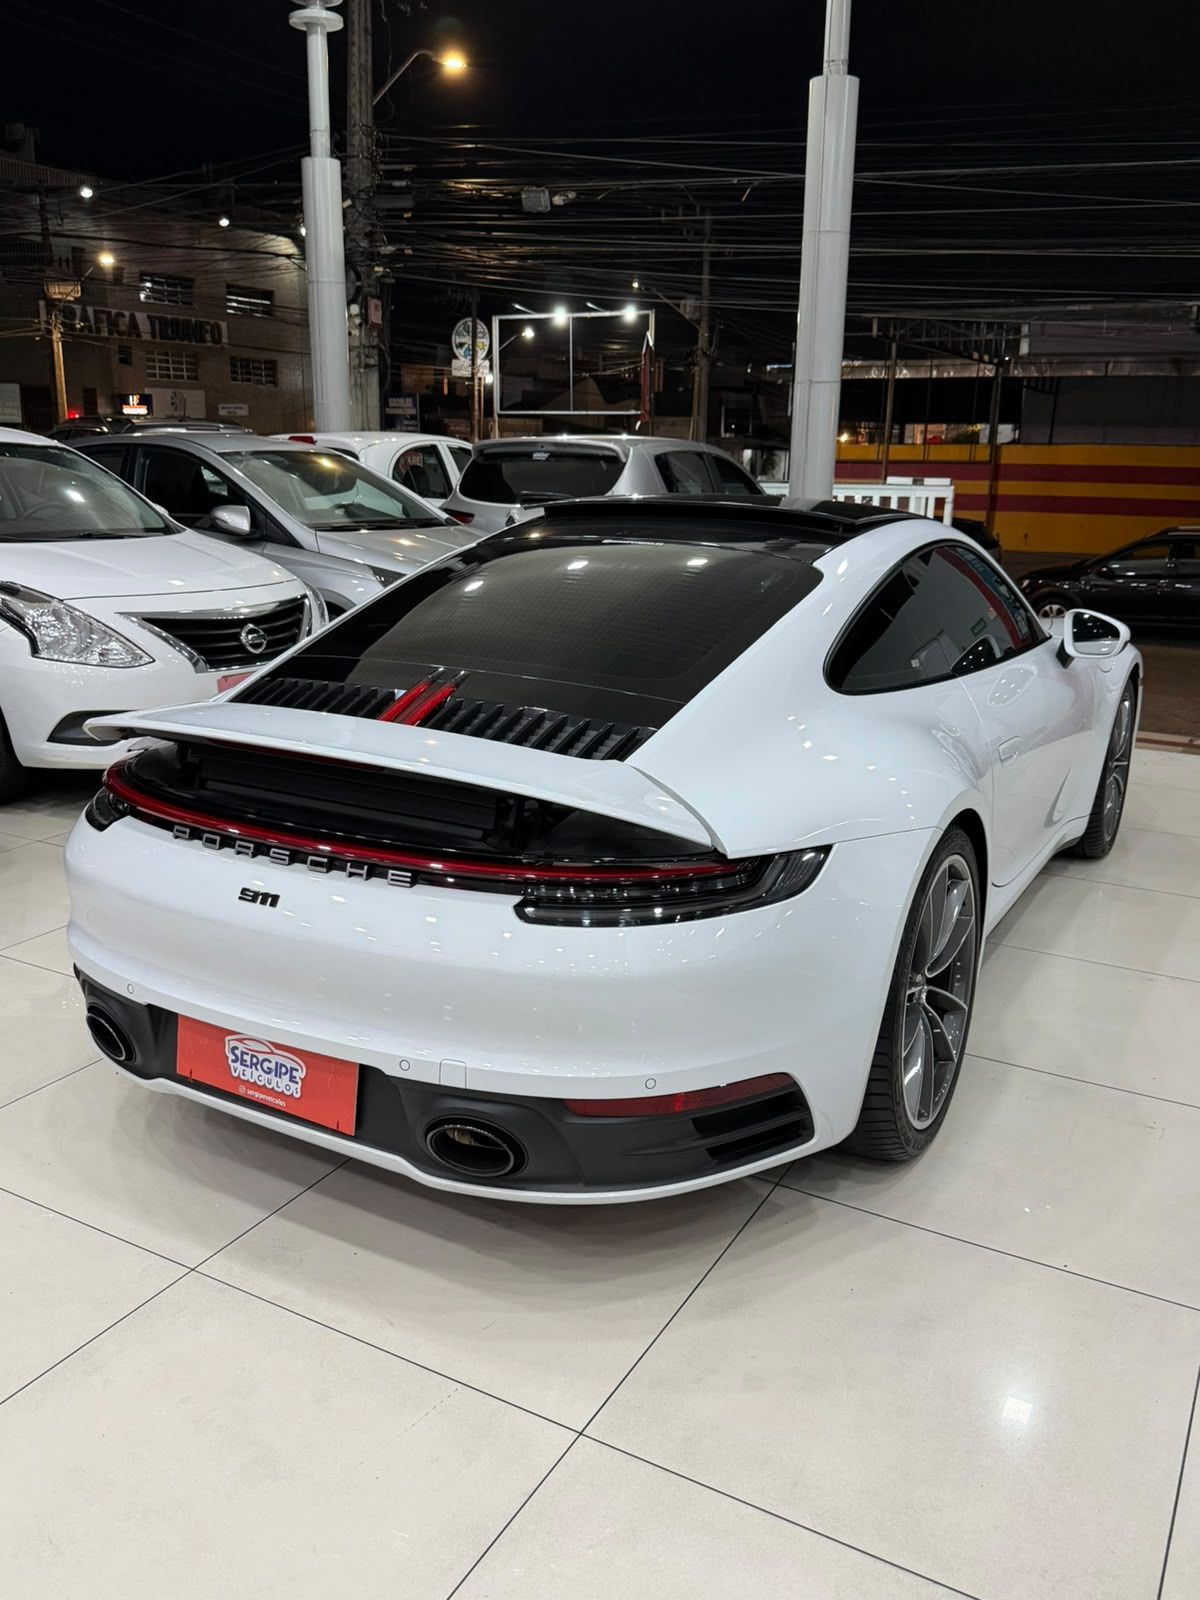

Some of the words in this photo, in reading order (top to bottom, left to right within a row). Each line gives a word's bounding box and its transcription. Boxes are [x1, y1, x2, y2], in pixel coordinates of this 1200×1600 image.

[46, 303, 143, 339] RAFICA
[173, 825, 412, 888] PORSCHE
[238, 887, 280, 908] 911
[230, 1045, 300, 1085] SERGIPE
